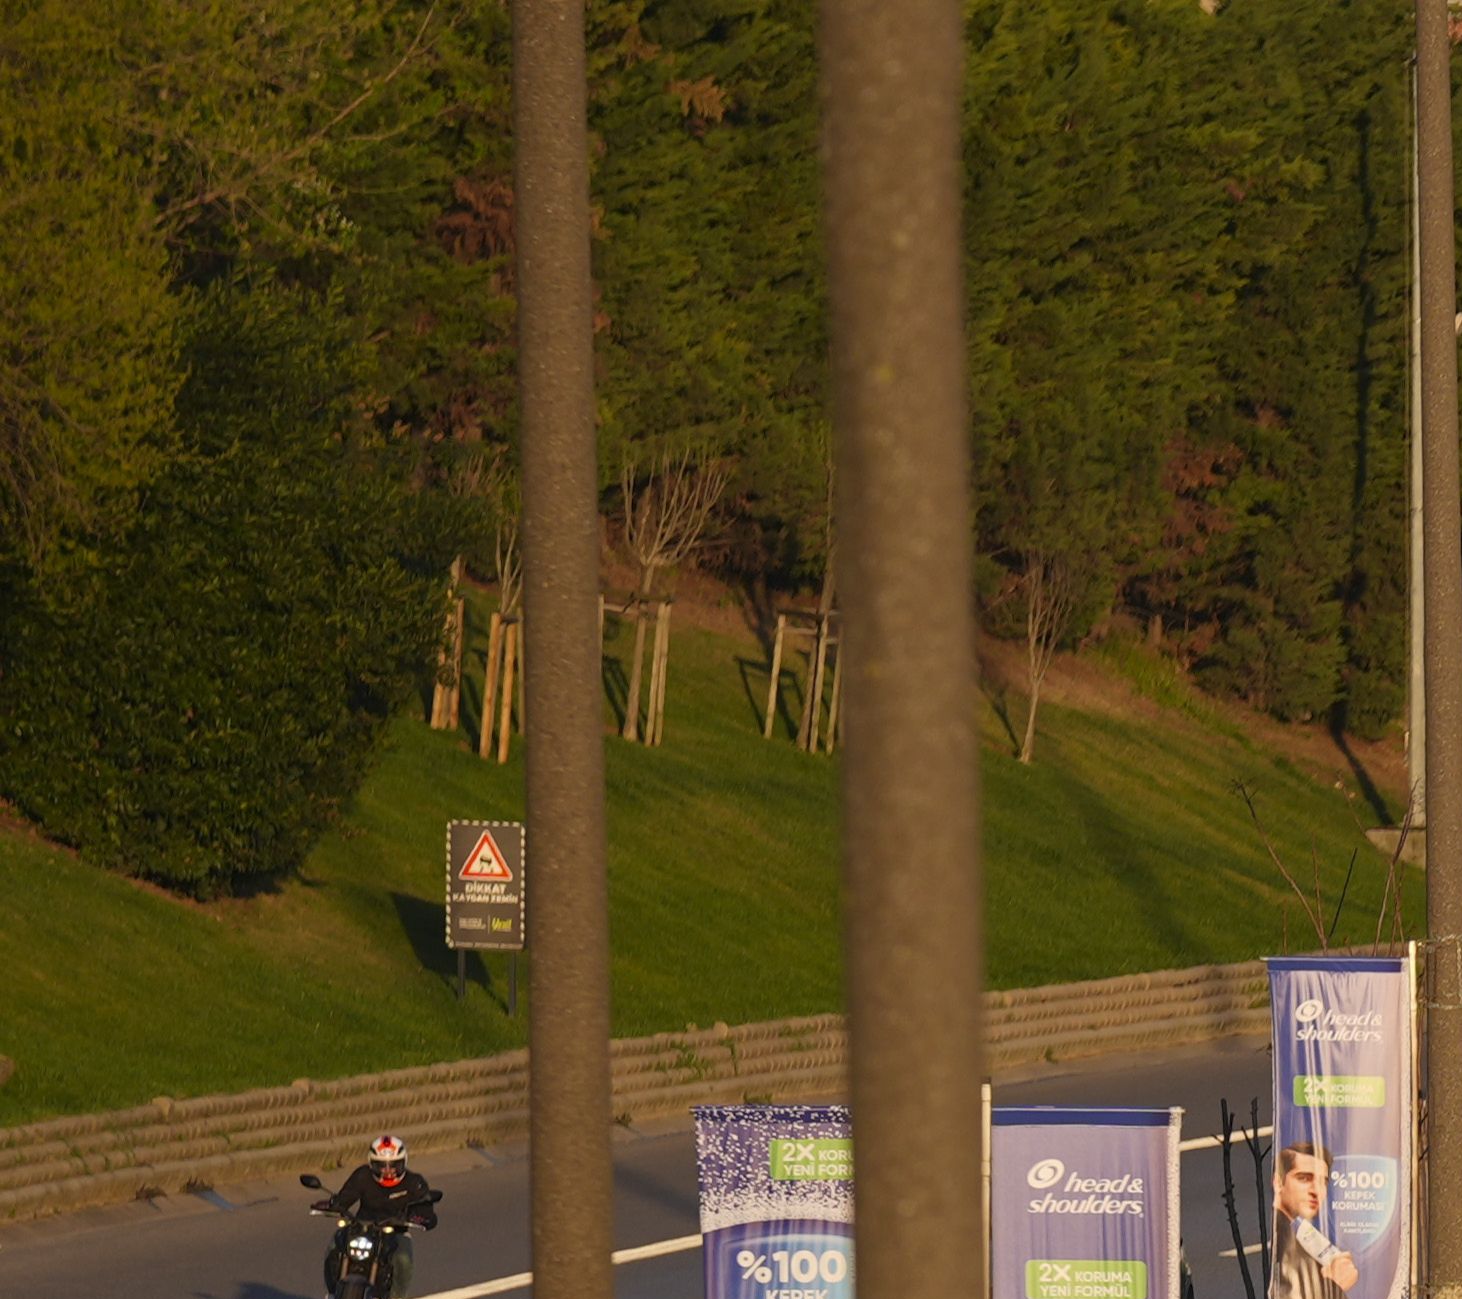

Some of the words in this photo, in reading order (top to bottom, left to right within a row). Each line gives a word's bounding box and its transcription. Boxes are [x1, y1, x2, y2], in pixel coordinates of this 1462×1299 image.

[465, 881, 506, 894] DİKKAT
[1297, 1025, 1383, 1041] shoulders
[1304, 1078, 1328, 1093] 2X
[783, 1142, 815, 1161] 2X
[784, 1162, 815, 1176] YENİ
[1331, 1171, 1385, 1189] %100
[1344, 1190, 1376, 1199] KEPEK
[1027, 1193, 1144, 1215] shoulders
[737, 1250, 847, 1284] %100
[1039, 1263, 1071, 1282] 2X
[1075, 1272, 1132, 1283] KORUMA
[1040, 1283, 1071, 1296] YENİ
[1075, 1283, 1132, 1297] FORMÜL
